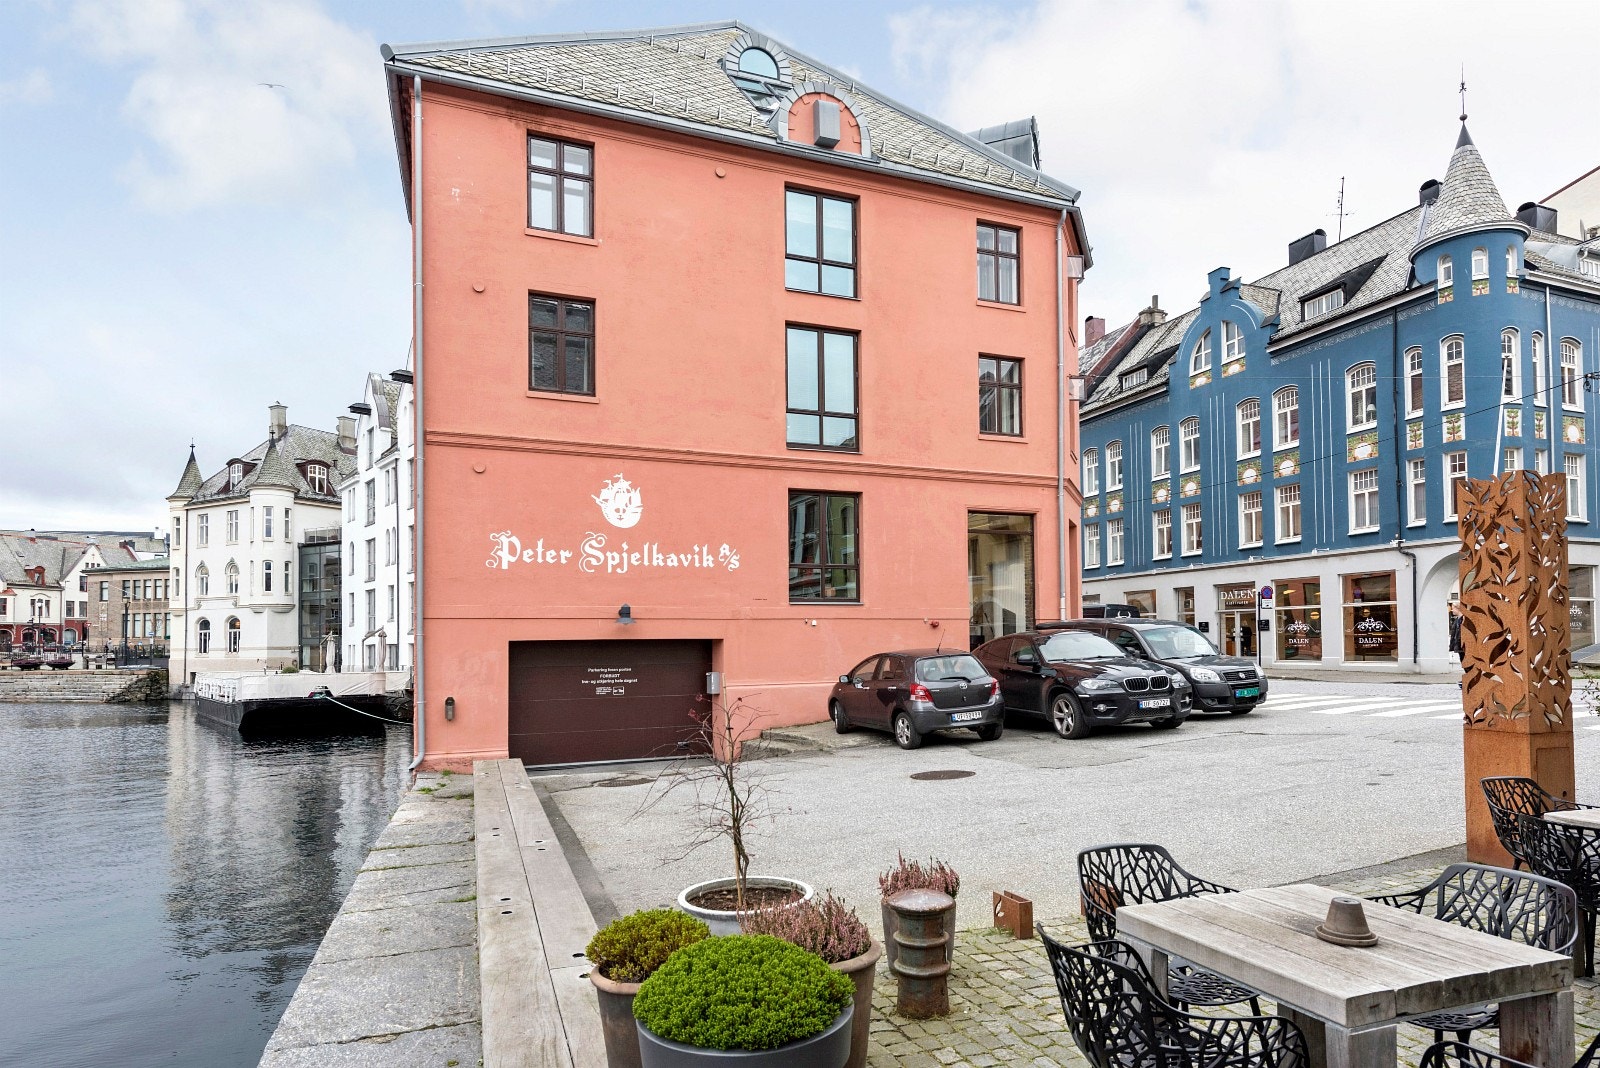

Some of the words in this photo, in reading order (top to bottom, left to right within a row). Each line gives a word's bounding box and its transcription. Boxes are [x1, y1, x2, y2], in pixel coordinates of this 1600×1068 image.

[486, 531, 572, 570] Peter
[578, 532, 715, 573] Spjelkavik
[1220, 589, 1254, 600] DALEN
